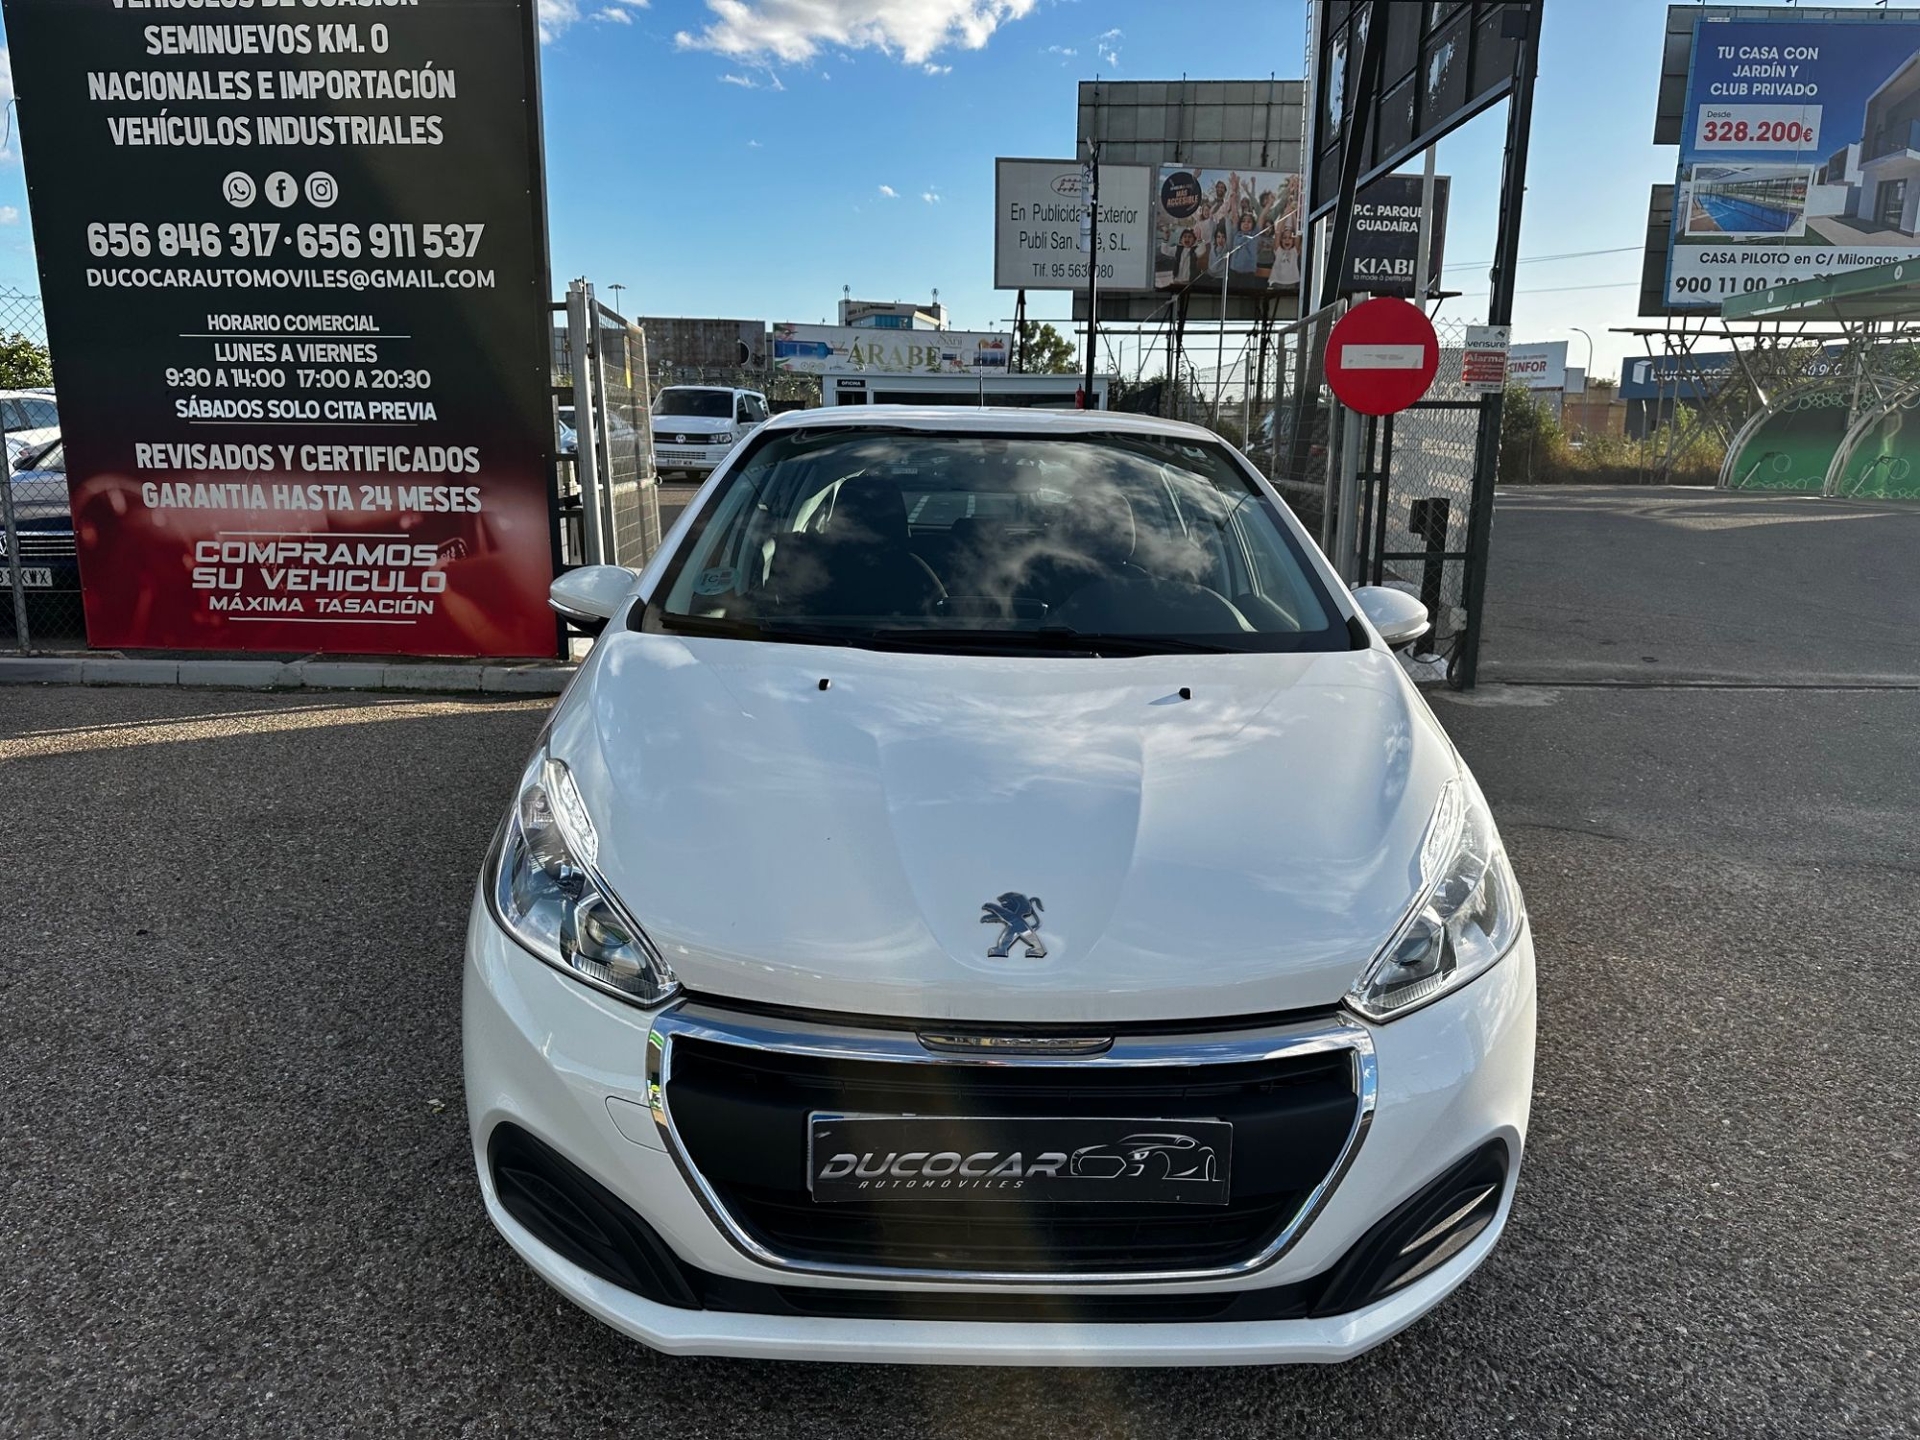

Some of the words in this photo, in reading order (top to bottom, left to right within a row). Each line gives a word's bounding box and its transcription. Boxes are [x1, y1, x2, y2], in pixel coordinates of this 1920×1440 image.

[145, 24, 312, 55] SEMINUEVOS
[317, 24, 365, 53] KM.
[371, 24, 388, 53] 0
[1717, 46, 1735, 59] TU
[1739, 46, 1779, 60] CASA
[1784, 47, 1819, 60] CON
[1732, 62, 1786, 77] JARDÍN
[1790, 65, 1799, 77] Y
[88, 70, 250, 100] NACIONALES
[258, 70, 274, 99] E
[279, 61, 456, 99] IMPORTACIÓN
[1710, 82, 1748, 95] CLUB
[1752, 83, 1818, 96] PRIVADO
[1707, 110, 1732, 118] Desde
[107, 109, 251, 146] VEHÍCULOS
[257, 116, 443, 145] INDUSTRIALES
[1703, 121, 1813, 142] 328.200€
[1011, 203, 1026, 221] En
[1033, 203, 1082, 222] Publicida
[1098, 205, 1138, 223] Exterior
[1353, 204, 1374, 216] P.C.
[1377, 205, 1422, 218] PARQUE
[1356, 218, 1418, 232] GUADAÍRA
[88, 223, 151, 257] 656
[158, 223, 221, 257] 846
[229, 223, 280, 256] 317
[298, 224, 361, 258] 656
[369, 224, 415, 258] 911
[423, 224, 484, 258] 537
[1019, 231, 1047, 249] Publi
[1051, 231, 1072, 250] San
[1109, 233, 1131, 251] S.L.
[1354, 258, 1414, 275] KIABI
[1700, 252, 1737, 264] CASA
[1741, 253, 1790, 264] PILOTO
[1794, 255, 1811, 264] en
[1816, 253, 1833, 266] C/
[87, 268, 495, 291] DUCOCARAUTOMOVILES@GMAIL.COM
[1032, 263, 1048, 277] Tlf.
[1052, 264, 1065, 277] 95
[1676, 277, 1711, 293] 900
[1718, 277, 1736, 293] 11
[1743, 277, 1767, 292] 00
[208, 314, 280, 331] HORARIO
[284, 315, 379, 332] COMERCIAL
[215, 343, 277, 362] LUNES
[281, 344, 294, 362] A
[297, 344, 377, 363] VIERNES
[1467, 353, 1504, 363] Alarma
[166, 368, 211, 388] 9:30
[215, 369, 228, 387] A
[231, 369, 286, 388] 14:00
[297, 369, 350, 388] 17:00
[355, 370, 368, 388] A
[371, 370, 431, 388] 20:30
[176, 396, 264, 418] SÁBADOS
[268, 401, 320, 419] SOLO
[324, 401, 364, 419] CITA
[369, 402, 437, 421] PREVIA
[136, 443, 275, 470] REVISADOS
[278, 445, 294, 470] Y
[301, 445, 480, 473] CERTIFICADOS
[142, 482, 265, 509] GARANTIA
[273, 485, 353, 511] HASTA
[360, 486, 392, 511] 24
[398, 486, 481, 512] MESES
[196, 541, 438, 566] COMPRAMOS
[192, 568, 243, 589] SU
[260, 569, 446, 593] VEHICULO
[209, 592, 304, 612] MÁXIMA
[315, 595, 434, 615] TASACIÓN
[819, 1152, 1067, 1178] DUCOCAR
[858, 1179, 1024, 1189] AUTOMÓVILES
